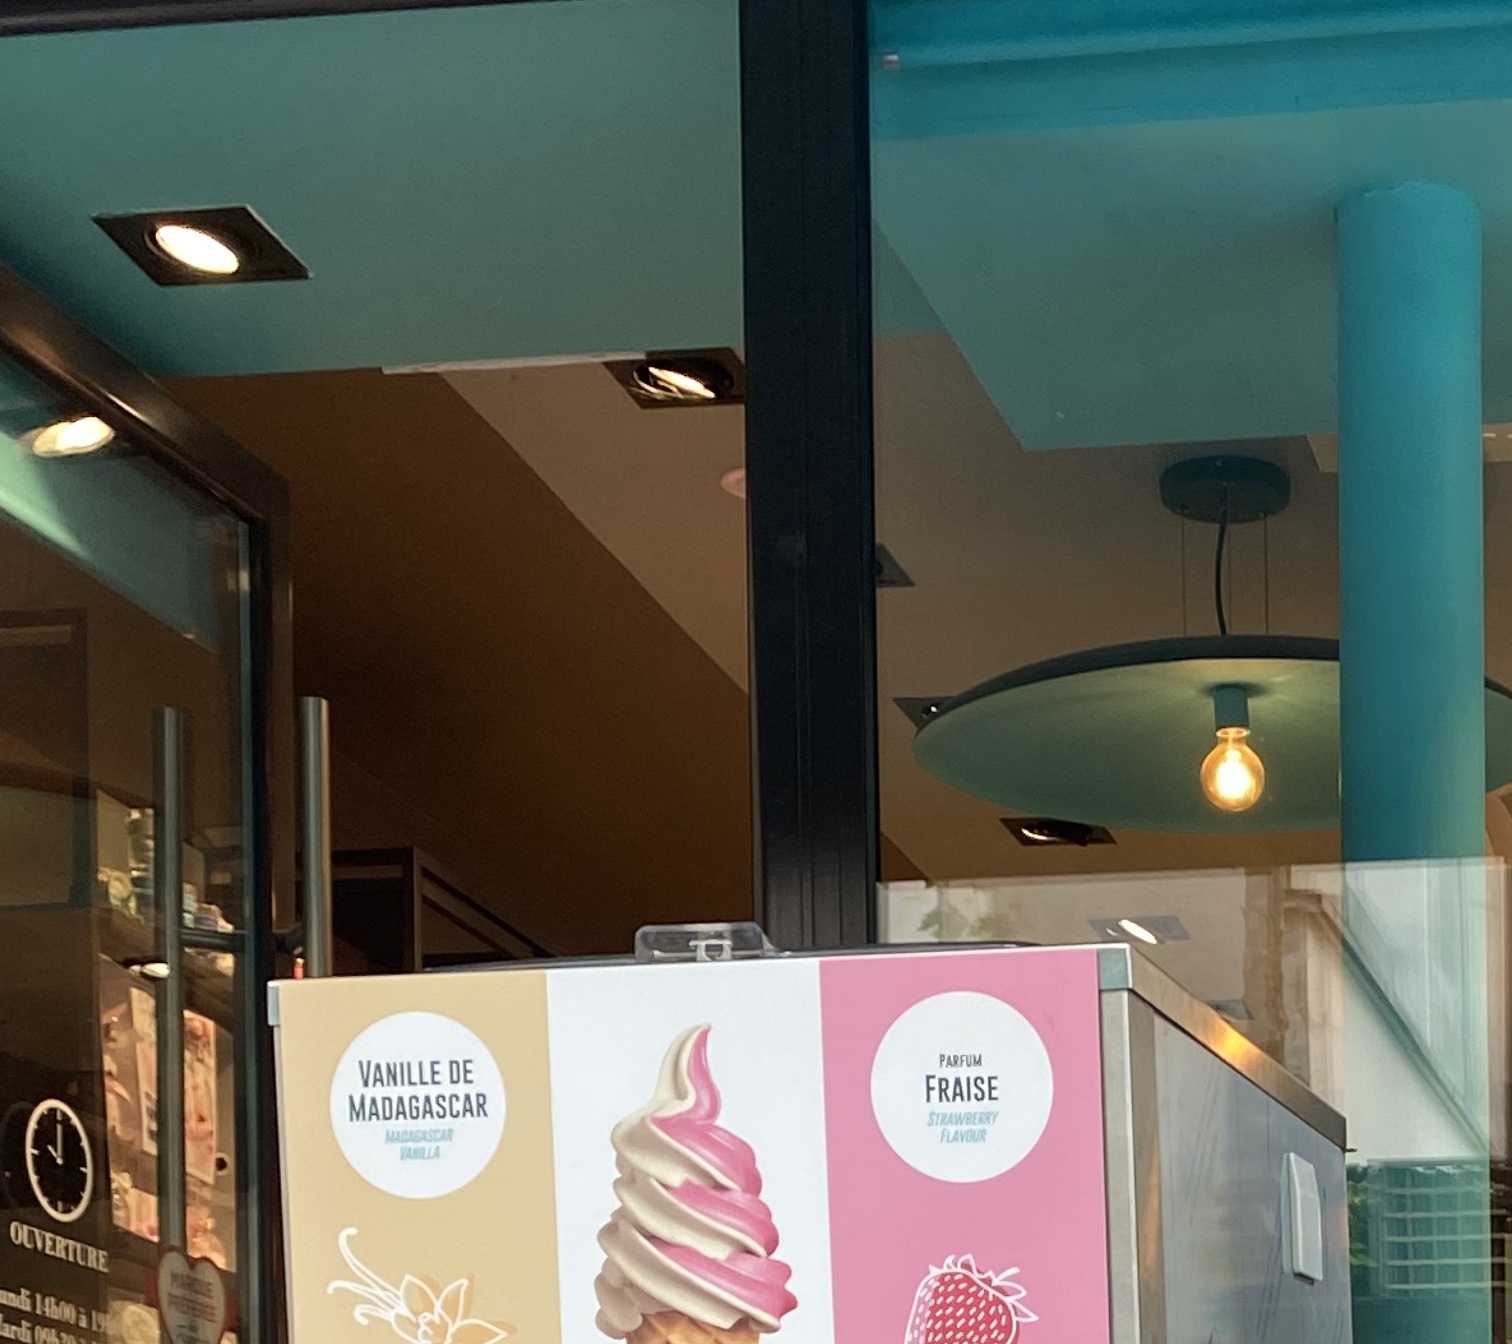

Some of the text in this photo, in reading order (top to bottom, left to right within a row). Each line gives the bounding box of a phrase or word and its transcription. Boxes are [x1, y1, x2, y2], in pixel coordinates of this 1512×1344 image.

[939, 1053, 982, 1069] PARFUM
[358, 1058, 475, 1088] VANILLE DE
[925, 1074, 999, 1103] FRAISE
[348, 1092, 489, 1123] MADAGASCAR
[927, 1110, 999, 1127] STRAWBERRY
[384, 1127, 454, 1144] MADAGASCAR
[939, 1127, 987, 1144] FLAVOUR
[399, 1145, 441, 1161] VANILLA
[9, 1220, 110, 1274] OUVERTURE
[78, 1305, 88, 1329] à
